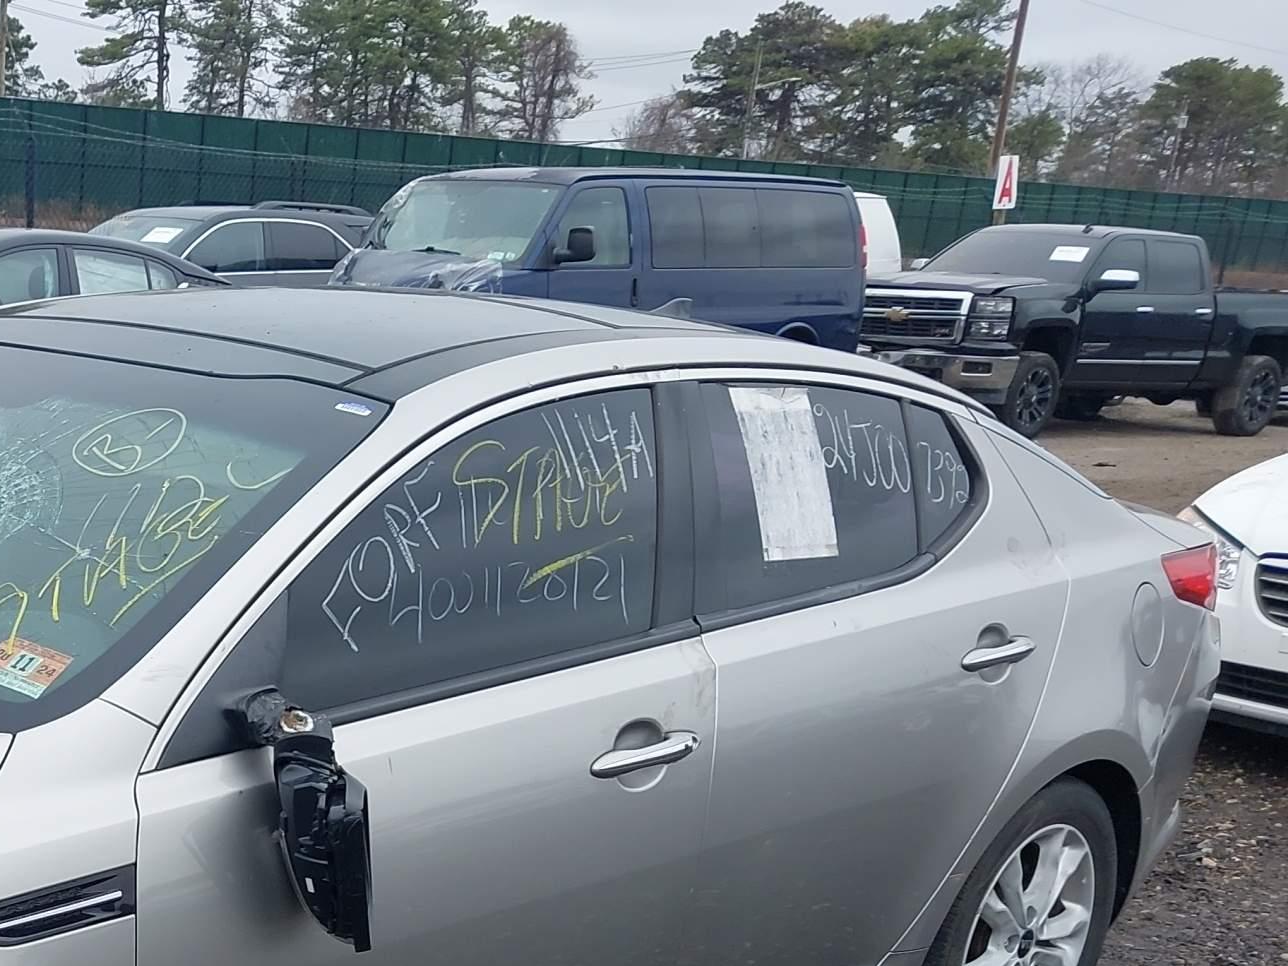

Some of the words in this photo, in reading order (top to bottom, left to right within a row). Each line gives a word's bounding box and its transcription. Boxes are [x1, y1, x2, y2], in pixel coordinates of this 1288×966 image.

[998, 158, 1013, 204] A
[10, 653, 35, 672] 11
[36, 664, 57, 678] 24
